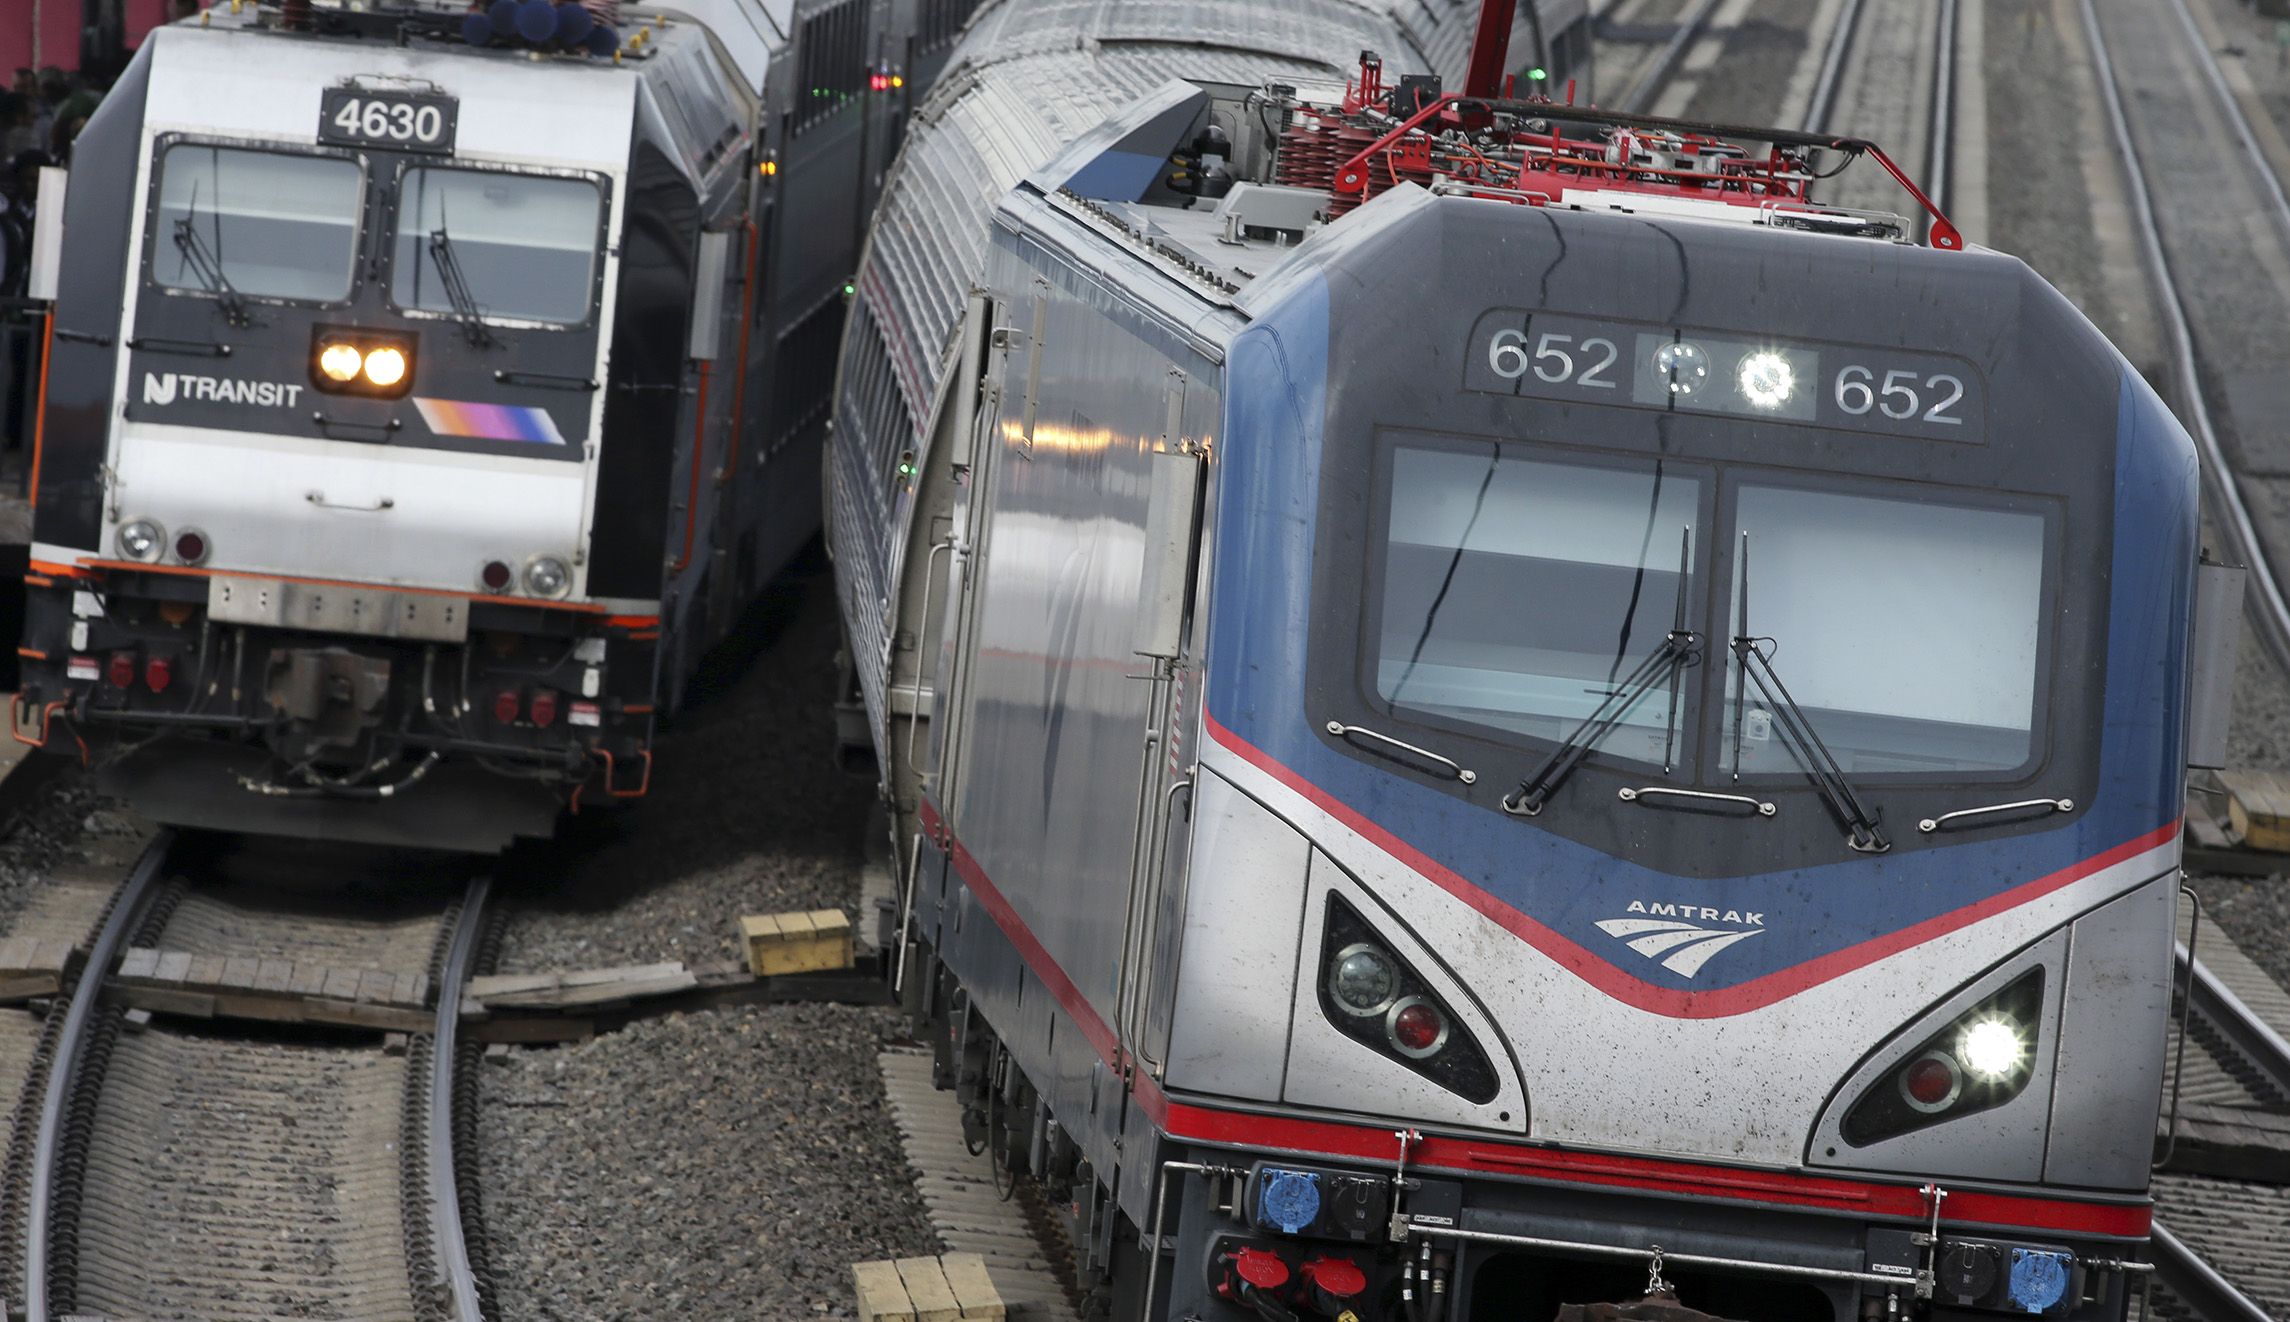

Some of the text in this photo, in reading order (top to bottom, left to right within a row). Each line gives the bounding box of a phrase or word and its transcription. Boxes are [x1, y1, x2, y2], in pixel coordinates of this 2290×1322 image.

[334, 98, 442, 143] 4630
[1489, 328, 1618, 389] 652
[143, 372, 304, 408] NJ TRANSIT
[1834, 365, 1964, 425] 652
[1626, 900, 1765, 926] AMTRAK
